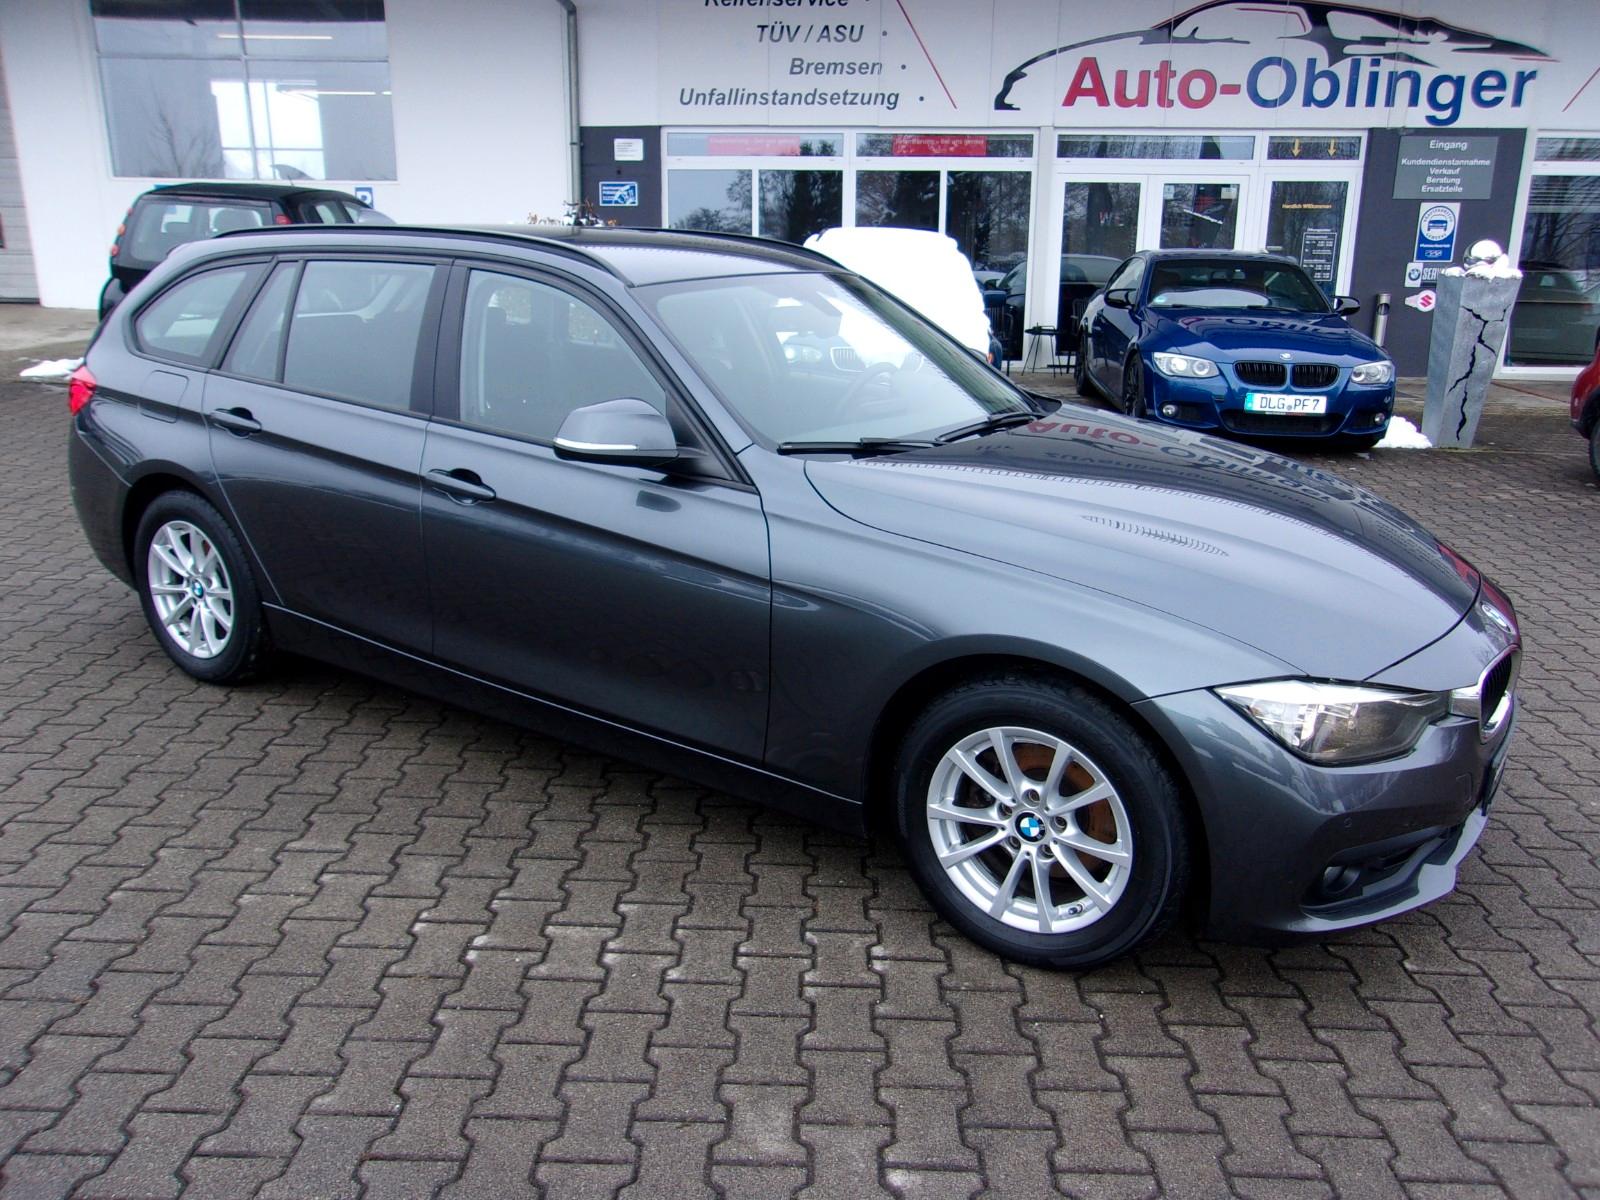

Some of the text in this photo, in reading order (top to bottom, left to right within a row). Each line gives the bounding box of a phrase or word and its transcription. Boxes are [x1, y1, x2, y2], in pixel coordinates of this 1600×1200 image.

[757, 21, 864, 43] TÜV / ASU
[789, 58, 882, 75] Bremsen
[1062, 56, 1537, 126] Auto-Oblinger
[679, 88, 900, 110] Unfallinstandsetzung
[1429, 140, 1468, 151] Eingang
[1401, 158, 1490, 166] Kundendienstannahme
[1426, 177, 1461, 185] Beratung
[1421, 185, 1463, 193] Ersatzteile
[1260, 396, 1285, 410] DLG
